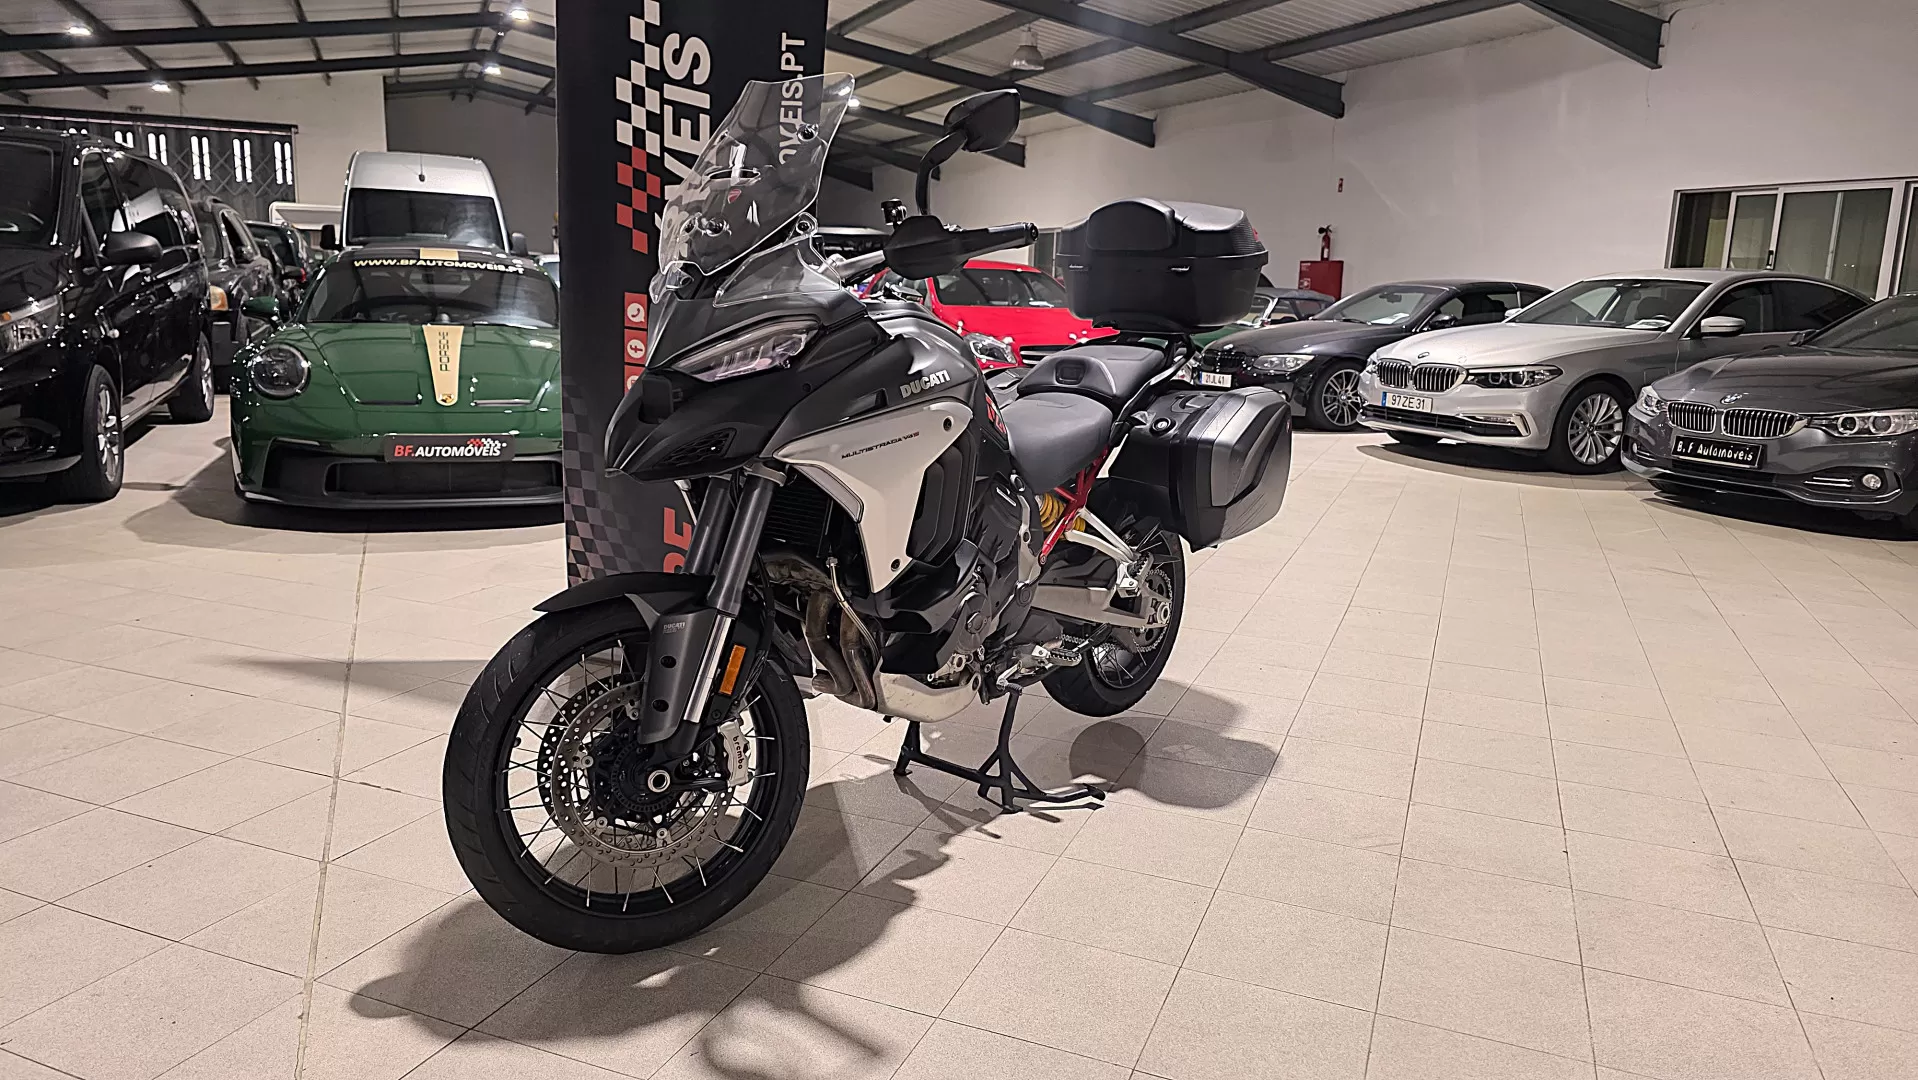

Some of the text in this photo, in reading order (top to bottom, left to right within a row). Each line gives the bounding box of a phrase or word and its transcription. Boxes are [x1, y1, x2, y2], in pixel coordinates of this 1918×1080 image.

[900, 369, 951, 399] DUCATI
[1391, 394, 1425, 410] 97 ZE 31
[841, 437, 903, 459] MULTISTRADA
[663, 621, 686, 630] DUCATI
[732, 735, 745, 770] brembo
